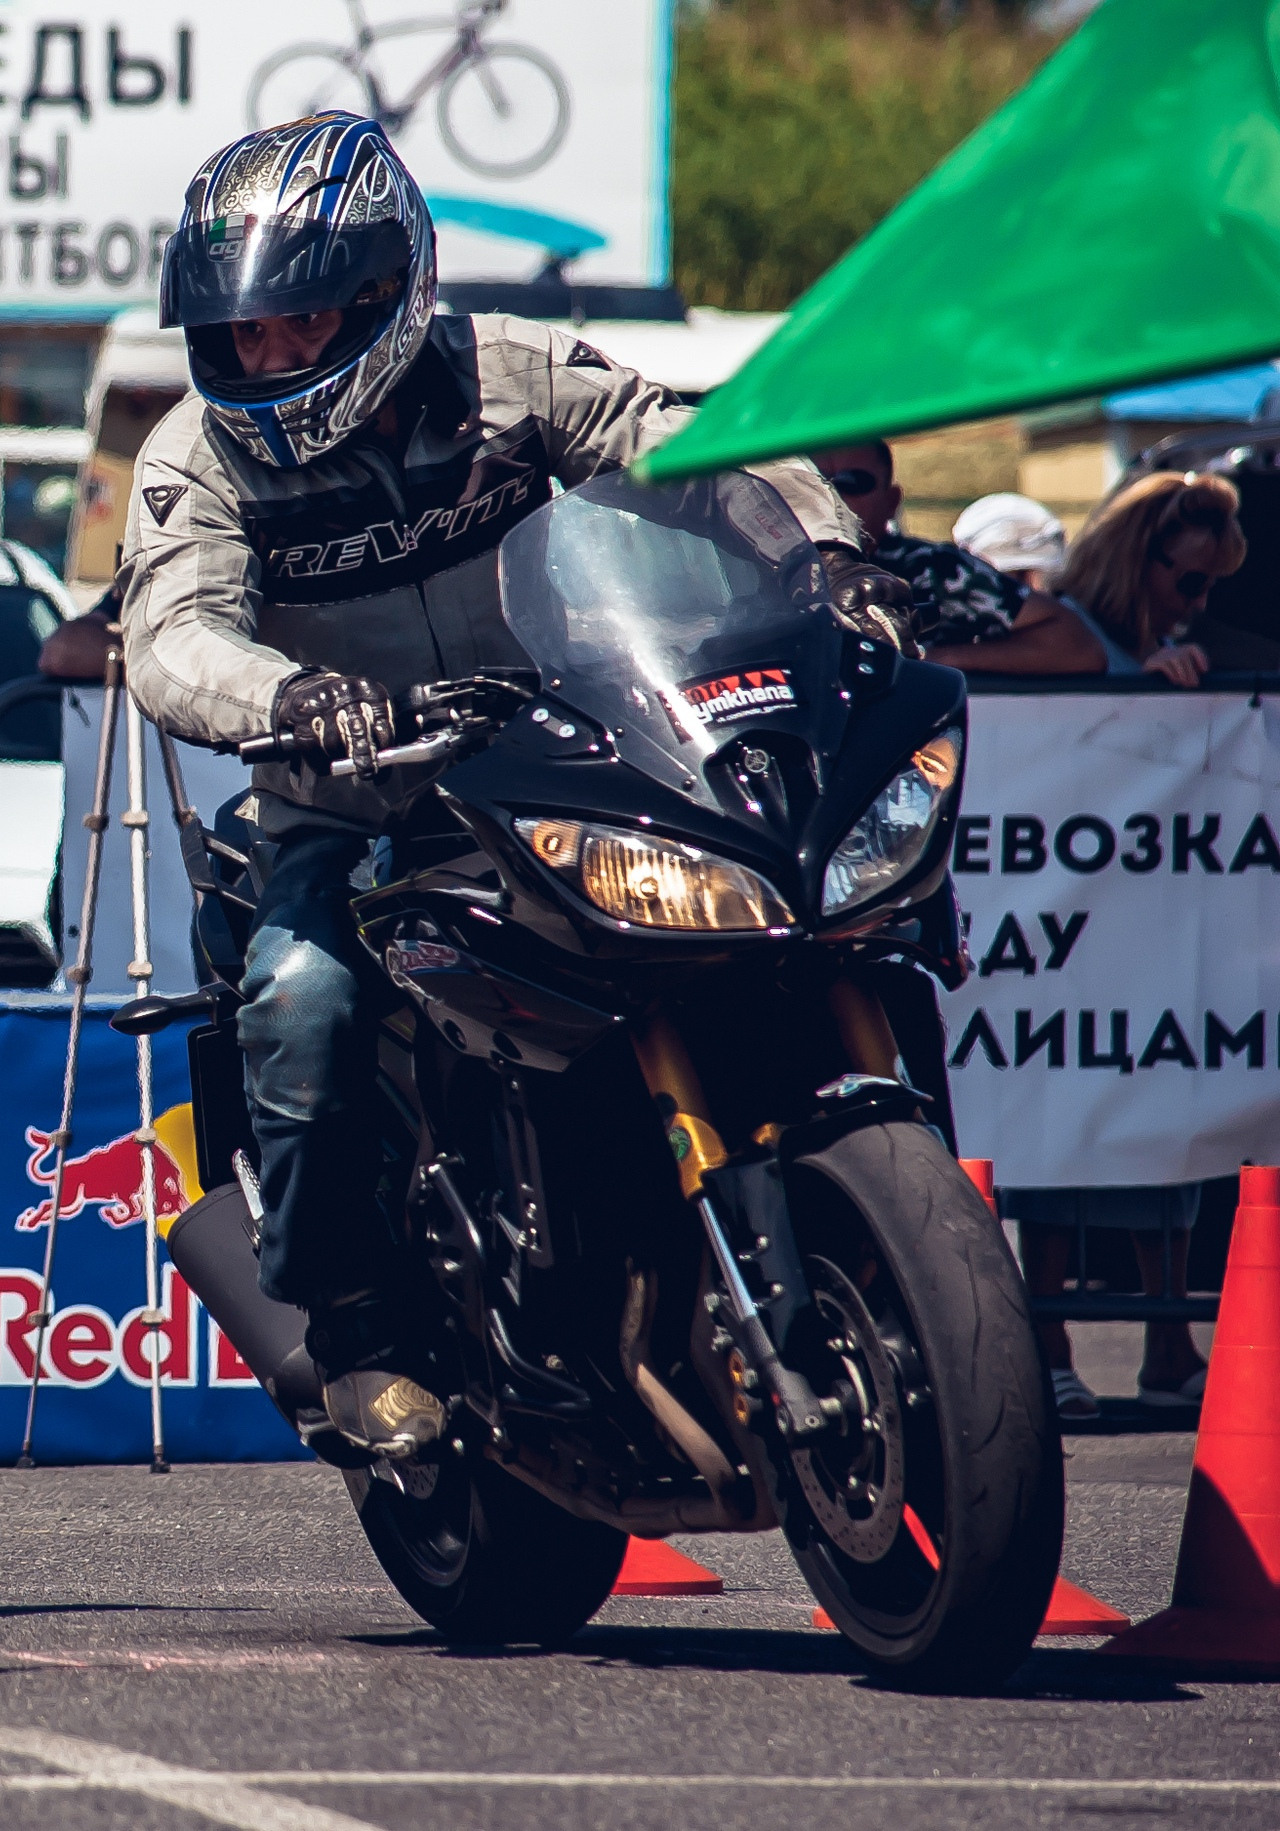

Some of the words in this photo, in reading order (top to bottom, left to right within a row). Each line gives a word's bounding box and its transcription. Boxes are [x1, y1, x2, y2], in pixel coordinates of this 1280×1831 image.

[691, 685, 795, 723] ymkhana
[963, 910, 1090, 978] ДУ
[948, 1007, 1280, 1075] ЛИЦАМ
